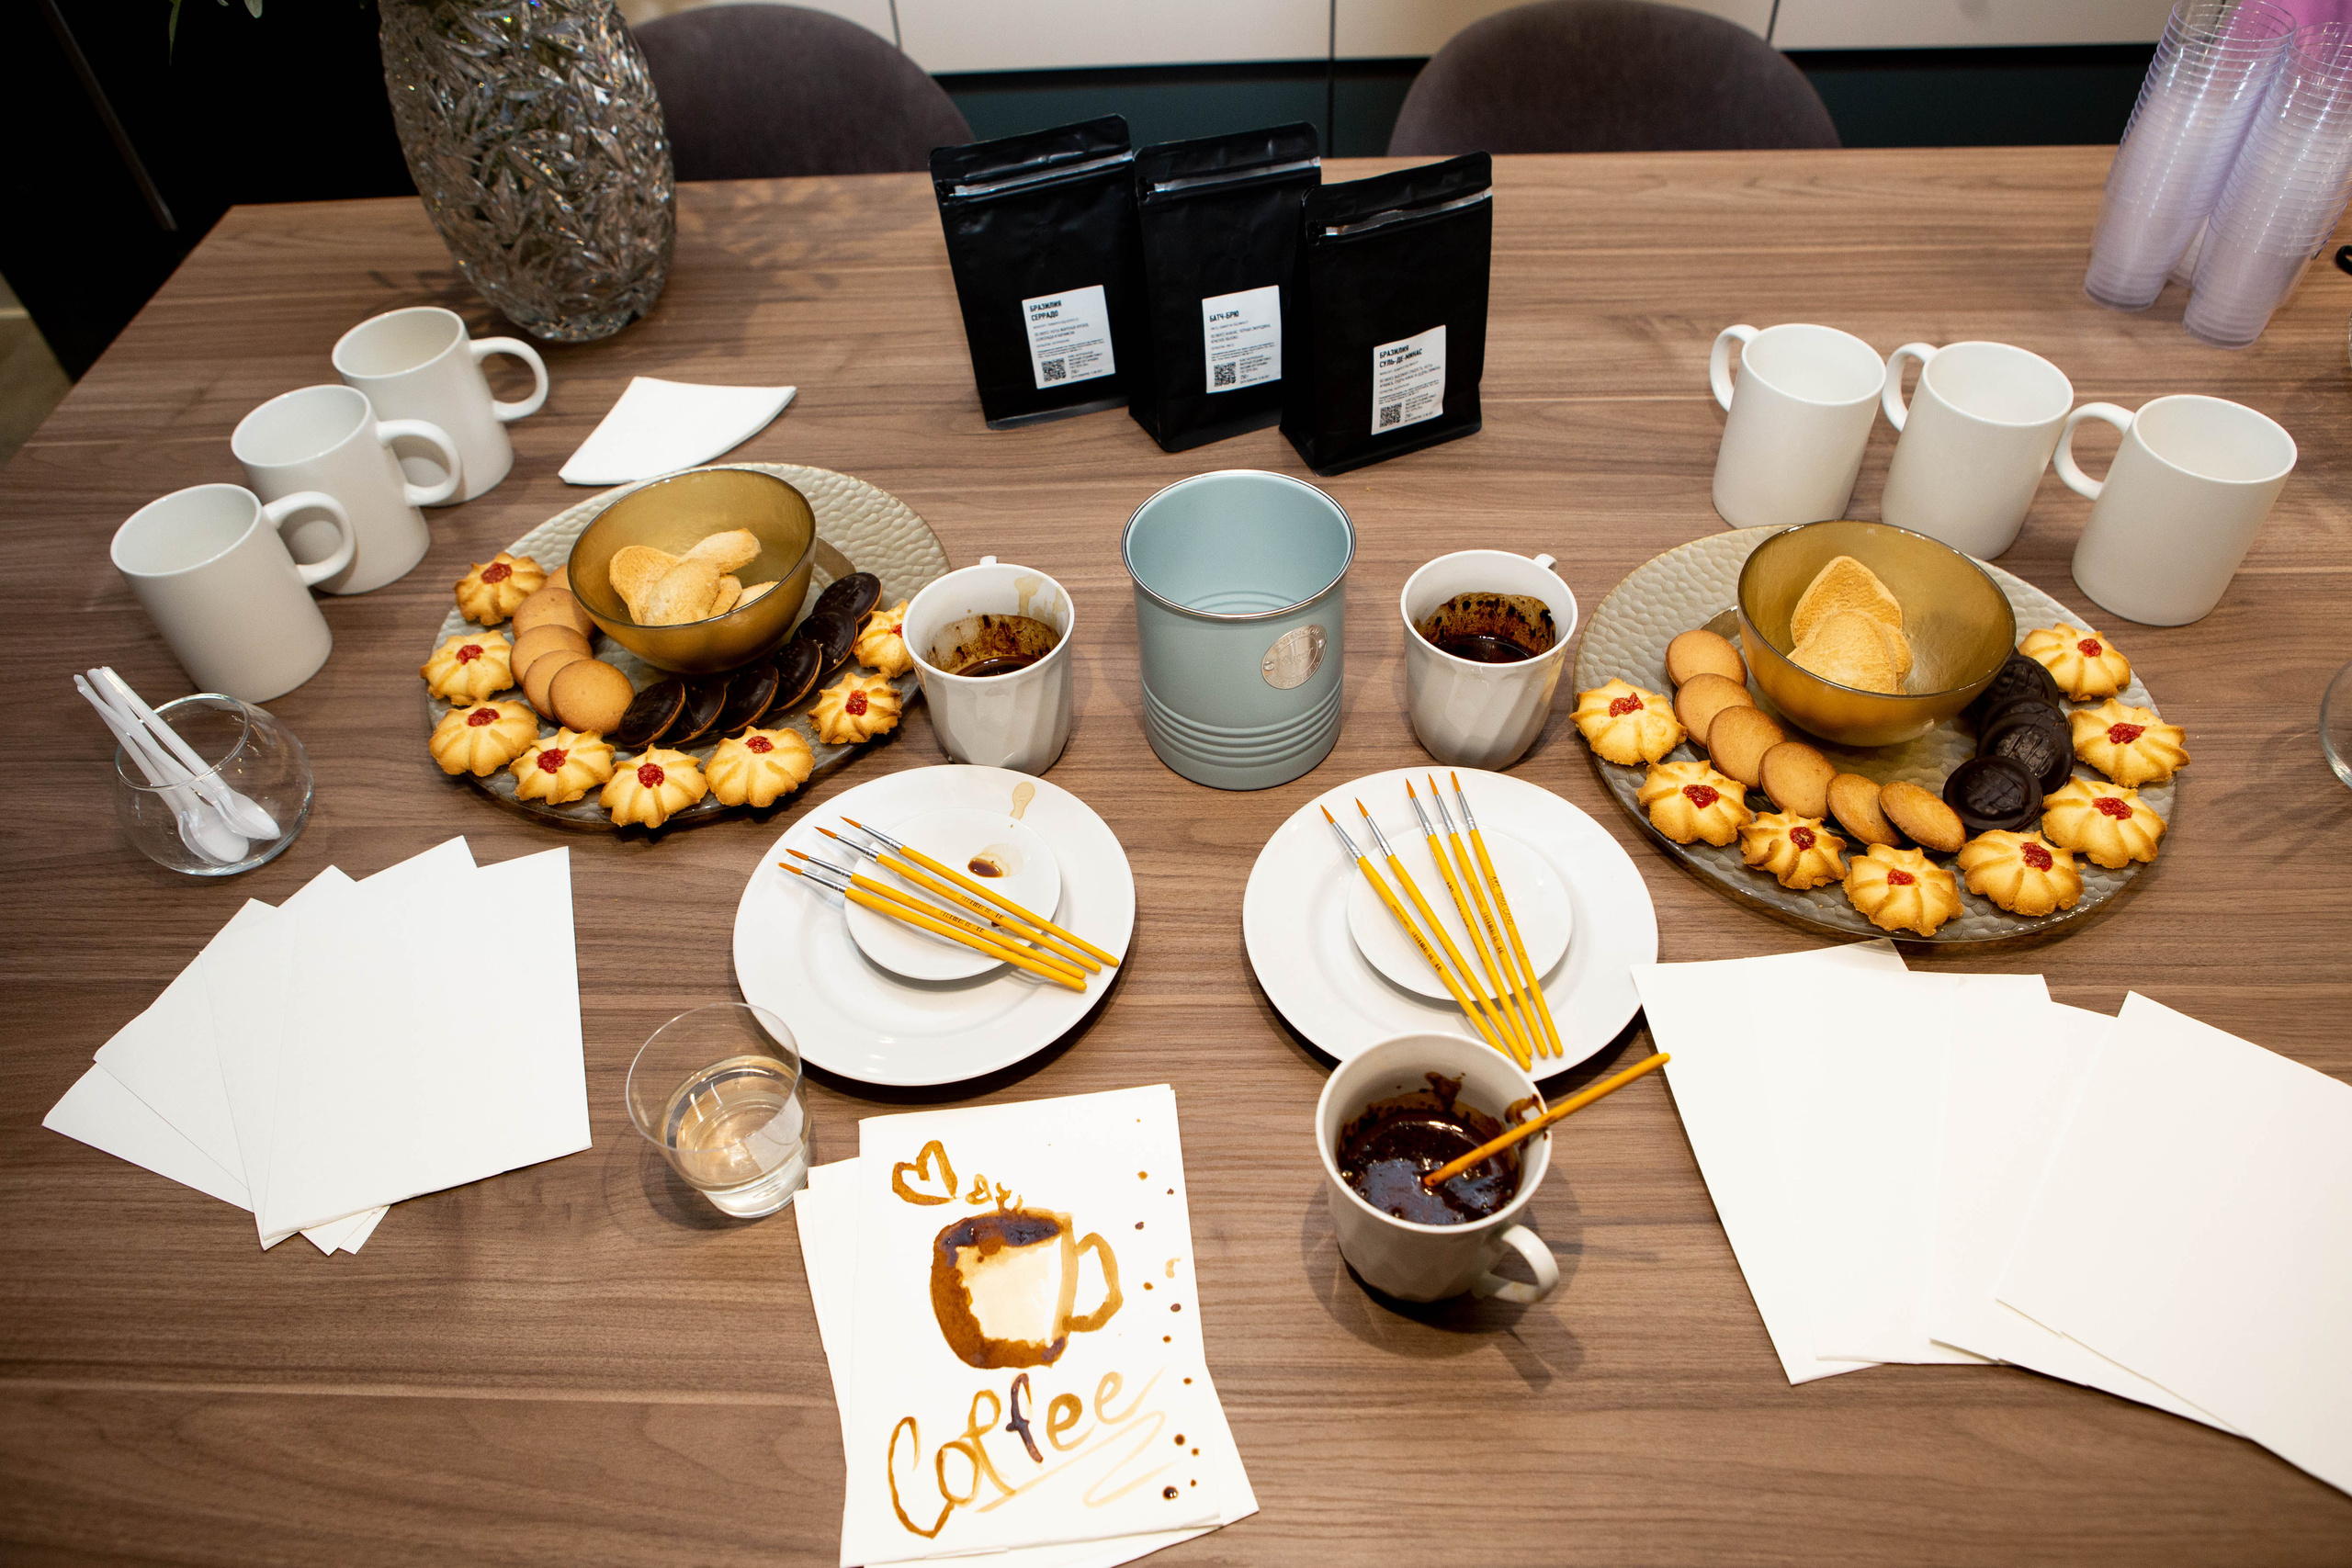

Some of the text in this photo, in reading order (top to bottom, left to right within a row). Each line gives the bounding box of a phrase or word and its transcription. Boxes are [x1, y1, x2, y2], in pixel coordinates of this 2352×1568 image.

[1030, 299, 1061, 312] БРАЗИЛИЯ
[1031, 310, 1058, 321] СЕРРАДО
[1209, 310, 1239, 322] БАТЧ-БРЮ
[1379, 344, 1409, 359] БРАЗИЛИЯ
[1379, 348, 1422, 367] СУЛЬ-ДЕ-МИНАС
[888, 1366, 1164, 1539] Coffee
